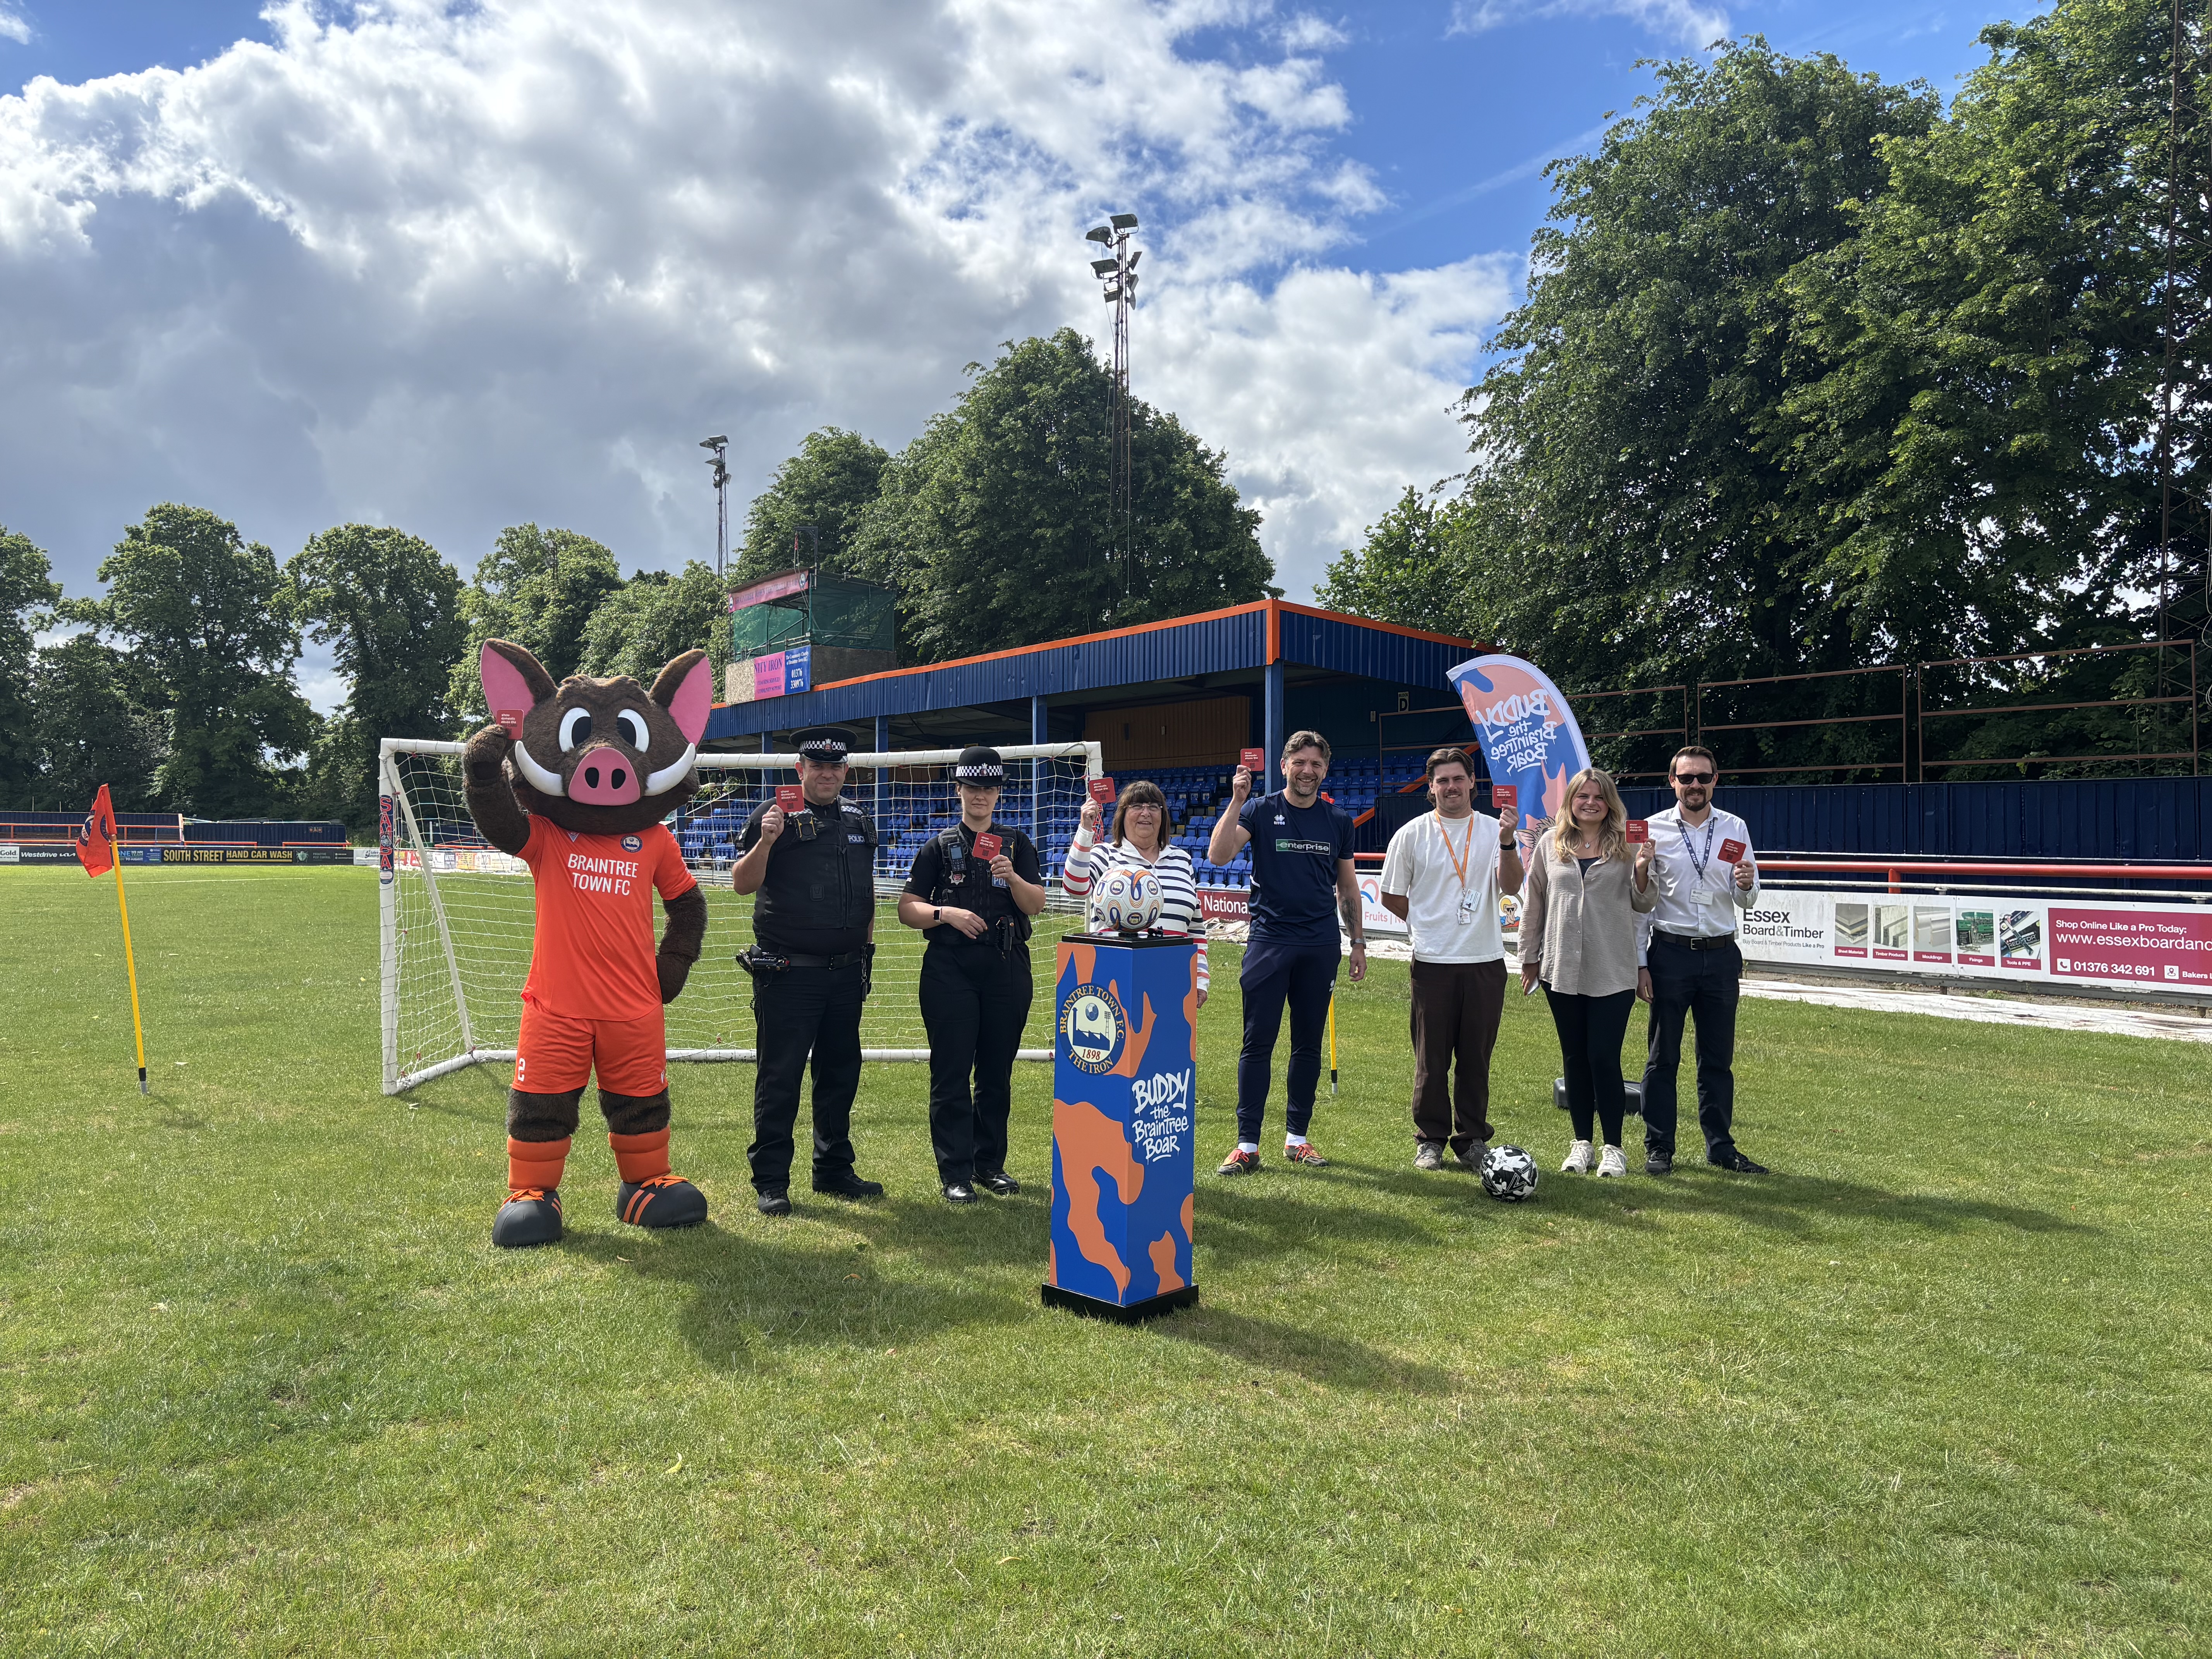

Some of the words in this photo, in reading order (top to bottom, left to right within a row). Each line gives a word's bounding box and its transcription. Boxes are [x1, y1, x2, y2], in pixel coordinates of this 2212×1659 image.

[769, 658, 782, 671] IRON
[791, 668, 802, 678] 01376
[1400, 698, 1408, 711] D
[1279, 842, 1329, 851] enterprise
[163, 850, 191, 862] SOUTH
[193, 850, 223, 862] STREET
[226, 850, 251, 859] HAND
[253, 850, 268, 859] CAR
[270, 850, 292, 859] WASH
[568, 854, 639, 878] BRAINTREE
[572, 872, 612, 893] TOWN
[615, 879, 630, 896] FC
[1204, 895, 1250, 914] Nationa
[1365, 912, 1388, 922] Fruits
[1743, 906, 1791, 924] Essex
[2056, 920, 2078, 929] Shop
[2080, 921, 2107, 930] Online
[2110, 922, 2129, 931] Like
[2139, 924, 2155, 932] Pro
[2157, 924, 2187, 935] Today:
[2074, 961, 2109, 973] 01376
[2111, 964, 2133, 974] 342
[2135, 965, 2155, 976] 691
[2182, 971, 2208, 979] Bakers
[1060, 985, 1094, 1034] BRAINTREE
[1097, 987, 1121, 1017] TOWN
[1068, 1049, 1087, 1072] THE
[1089, 1056, 1113, 1073] IRON
[1082, 1049, 1101, 1060] 1898
[1132, 1068, 1190, 1114] BUDDY
[1150, 1105, 1171, 1120] the
[1132, 1116, 1189, 1143] Braintree
